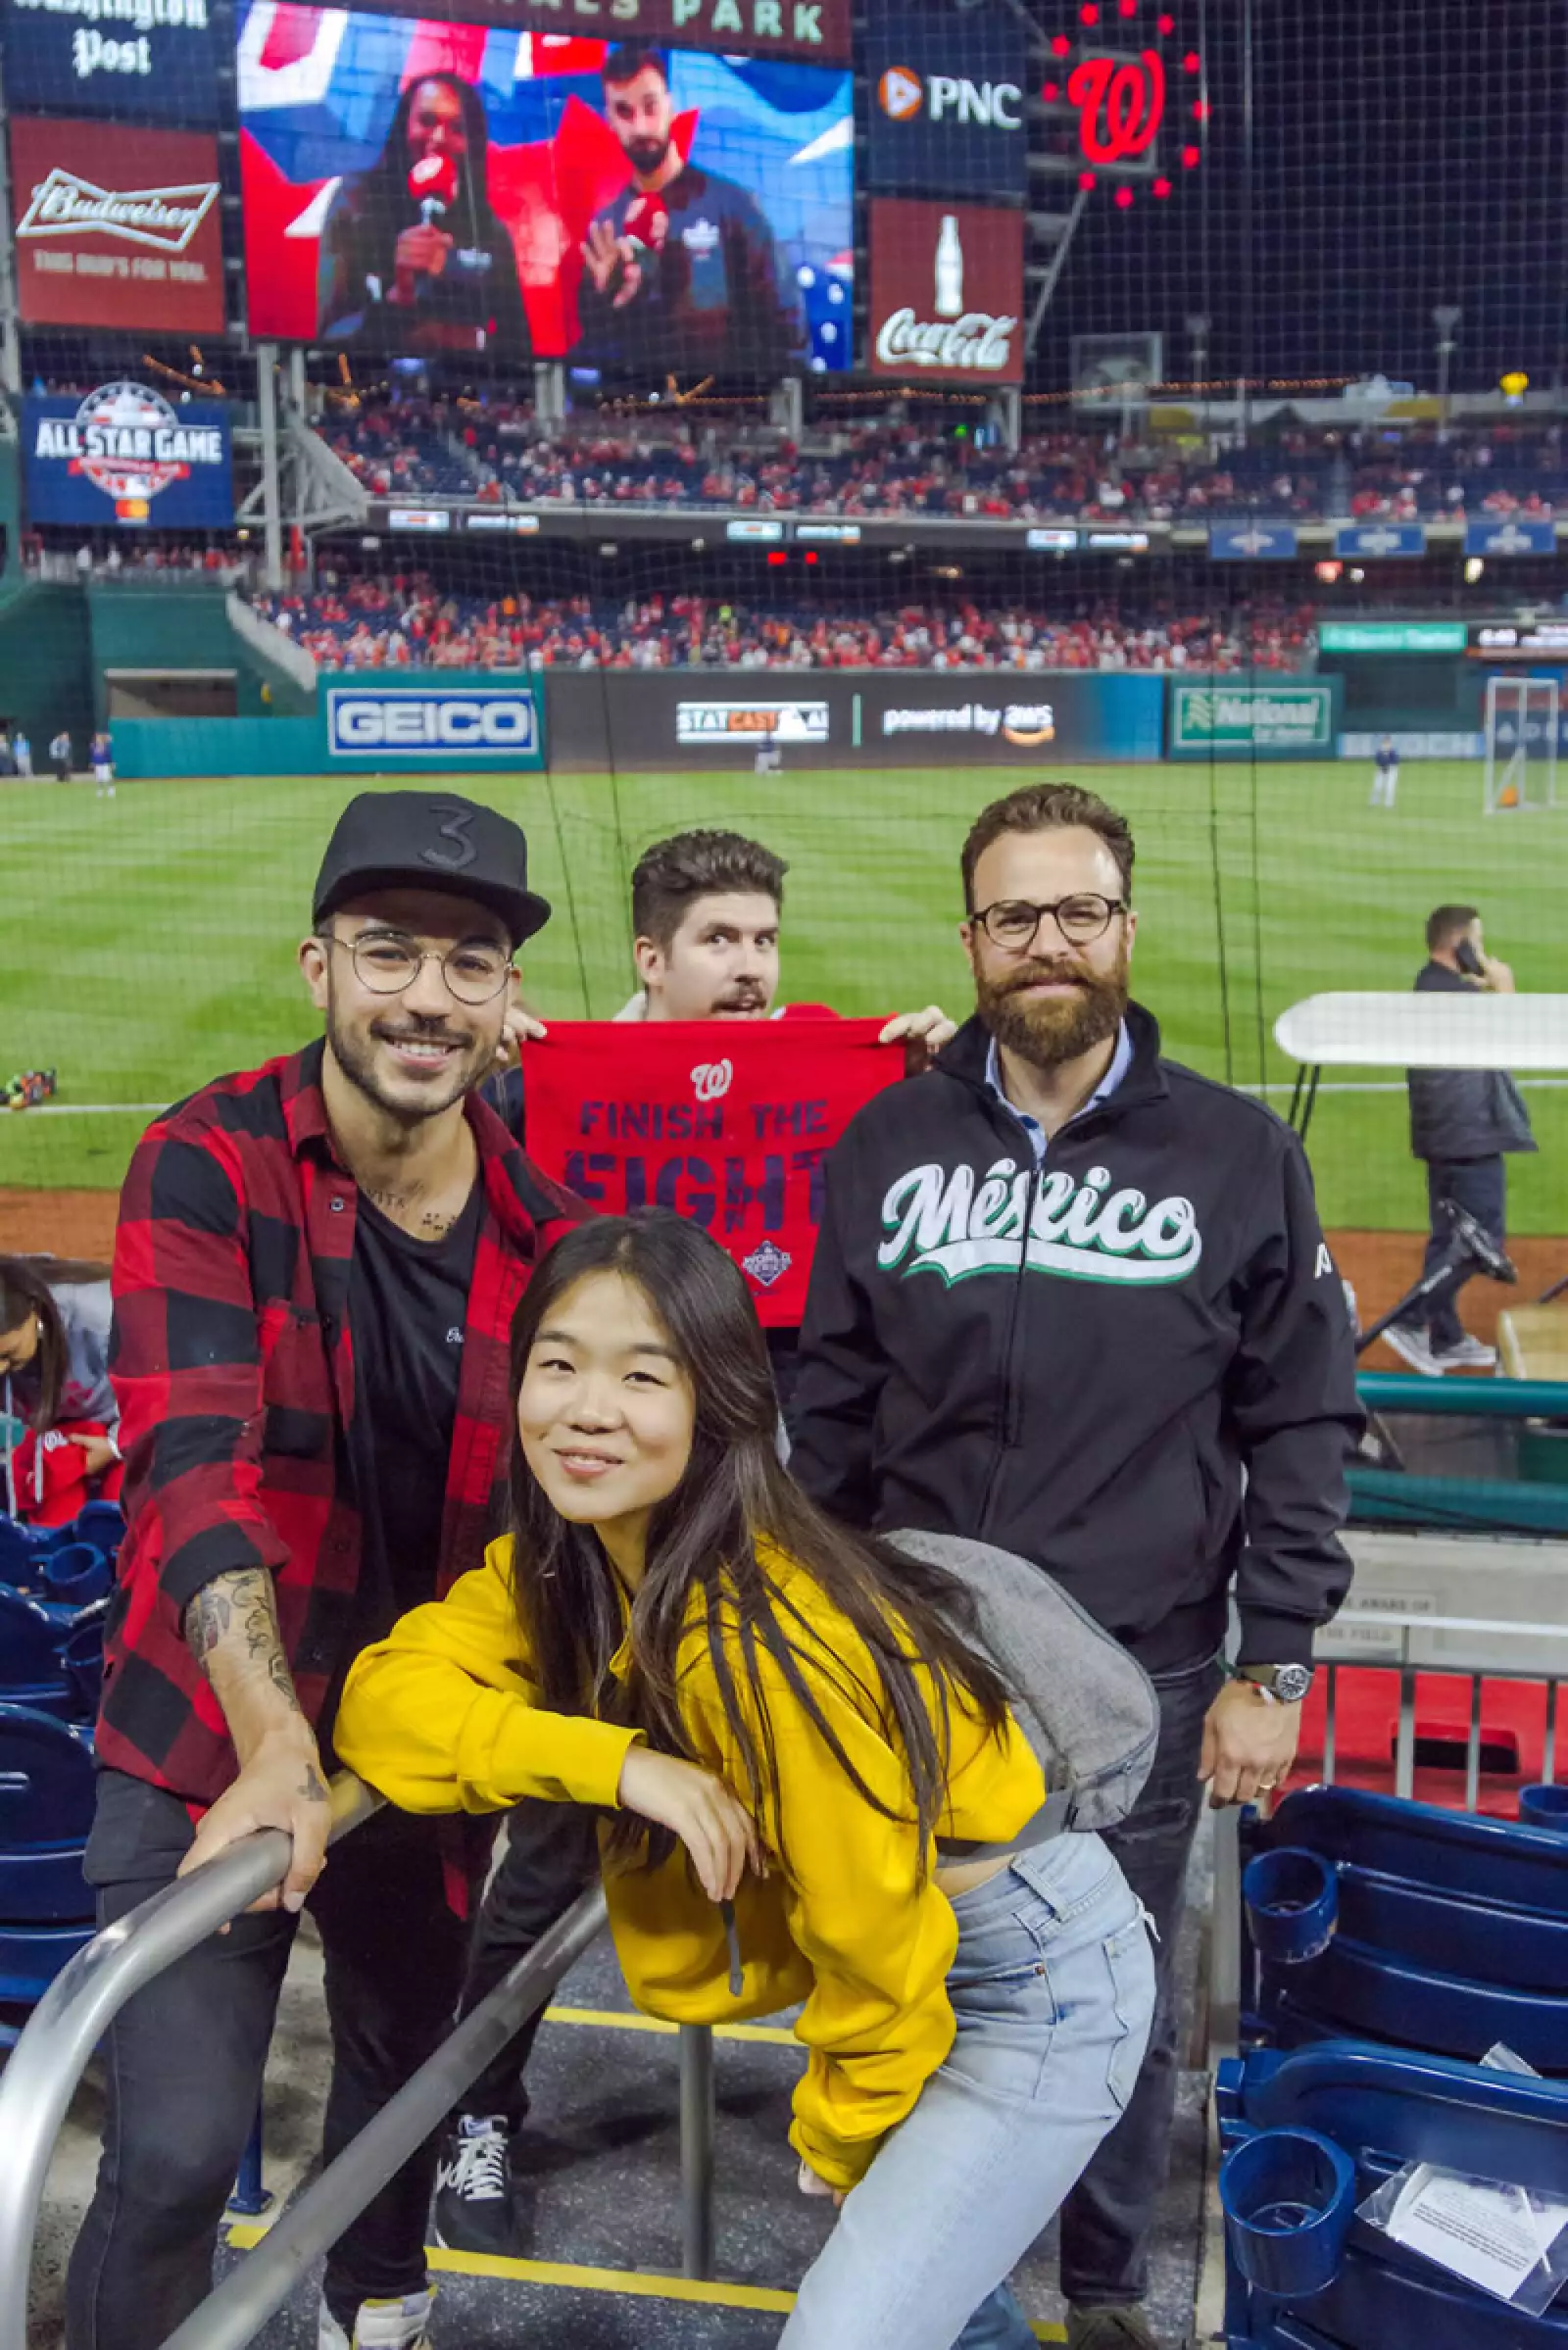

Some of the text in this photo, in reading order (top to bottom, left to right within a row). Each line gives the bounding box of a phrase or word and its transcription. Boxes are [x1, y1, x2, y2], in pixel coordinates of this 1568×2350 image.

[14, 0, 209, 29] hington
[670, 0, 823, 43] PARK
[73, 27, 152, 77] Post
[927, 75, 1022, 129] PNC
[1067, 49, 1165, 164] W
[31, 184, 199, 228] Budweiser
[85, 424, 152, 462] STAR
[155, 428, 222, 465] GAME
[337, 702, 529, 744] GEICO
[883, 703, 971, 737] powered
[973, 703, 1002, 737] by
[1214, 697, 1320, 724] National
[418, 804, 478, 869] 3
[690, 1058, 734, 1102] W
[580, 1100, 829, 1142] FINISH THE
[564, 1147, 829, 1234] FIGHT
[878, 1158, 1200, 1276] México
